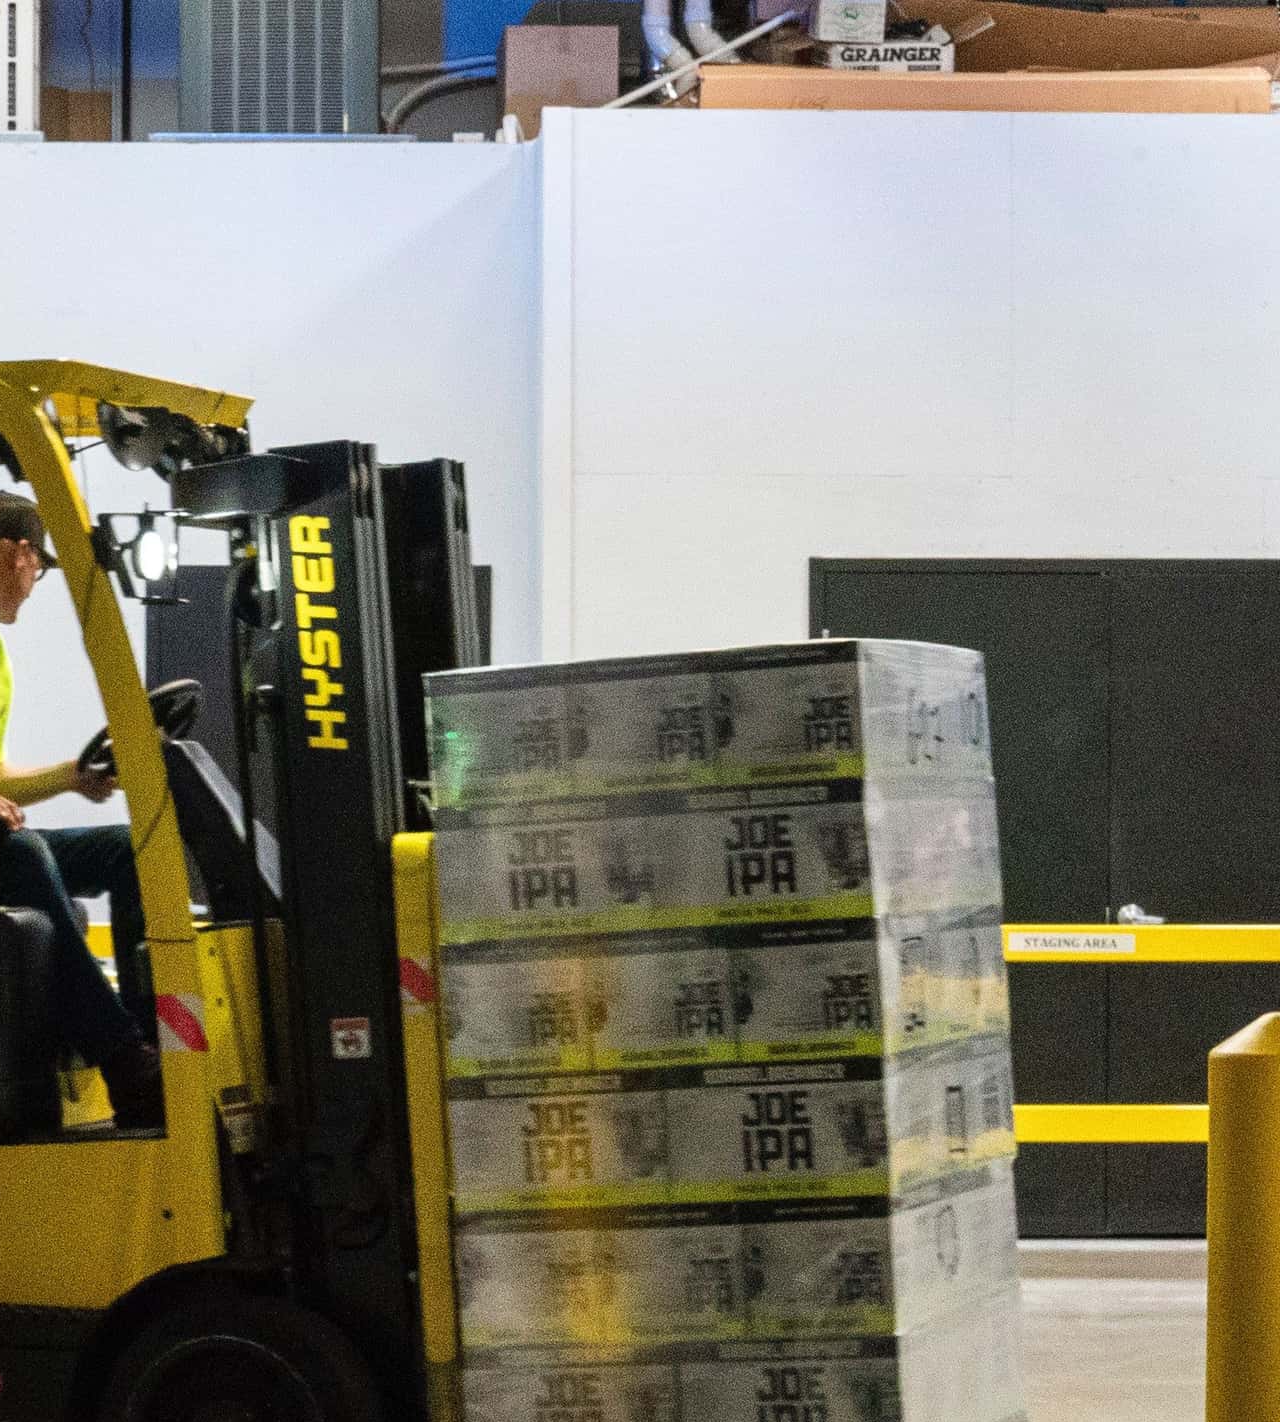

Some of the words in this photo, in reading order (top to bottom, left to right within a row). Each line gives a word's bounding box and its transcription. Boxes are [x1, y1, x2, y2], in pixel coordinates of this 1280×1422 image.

[840, 46, 941, 62] GRAINGER
[289, 515, 349, 750] HYSTER
[805, 695, 850, 720] JOE
[803, 720, 852, 750] IPA
[509, 831, 573, 864] JOE
[726, 814, 791, 850] JOE
[509, 866, 578, 911] IPA
[727, 851, 798, 896] IPA
[1024, 938, 1080, 949] STAGING
[1083, 938, 1117, 949] AREA
[825, 974, 870, 999] JOE
[824, 998, 873, 1030] IPA
[522, 1100, 589, 1136] JOE
[742, 1090, 811, 1127] JOE
[523, 1138, 594, 1183] IPA
[743, 1127, 815, 1173] IPA
[756, 1364, 826, 1402] JOE
